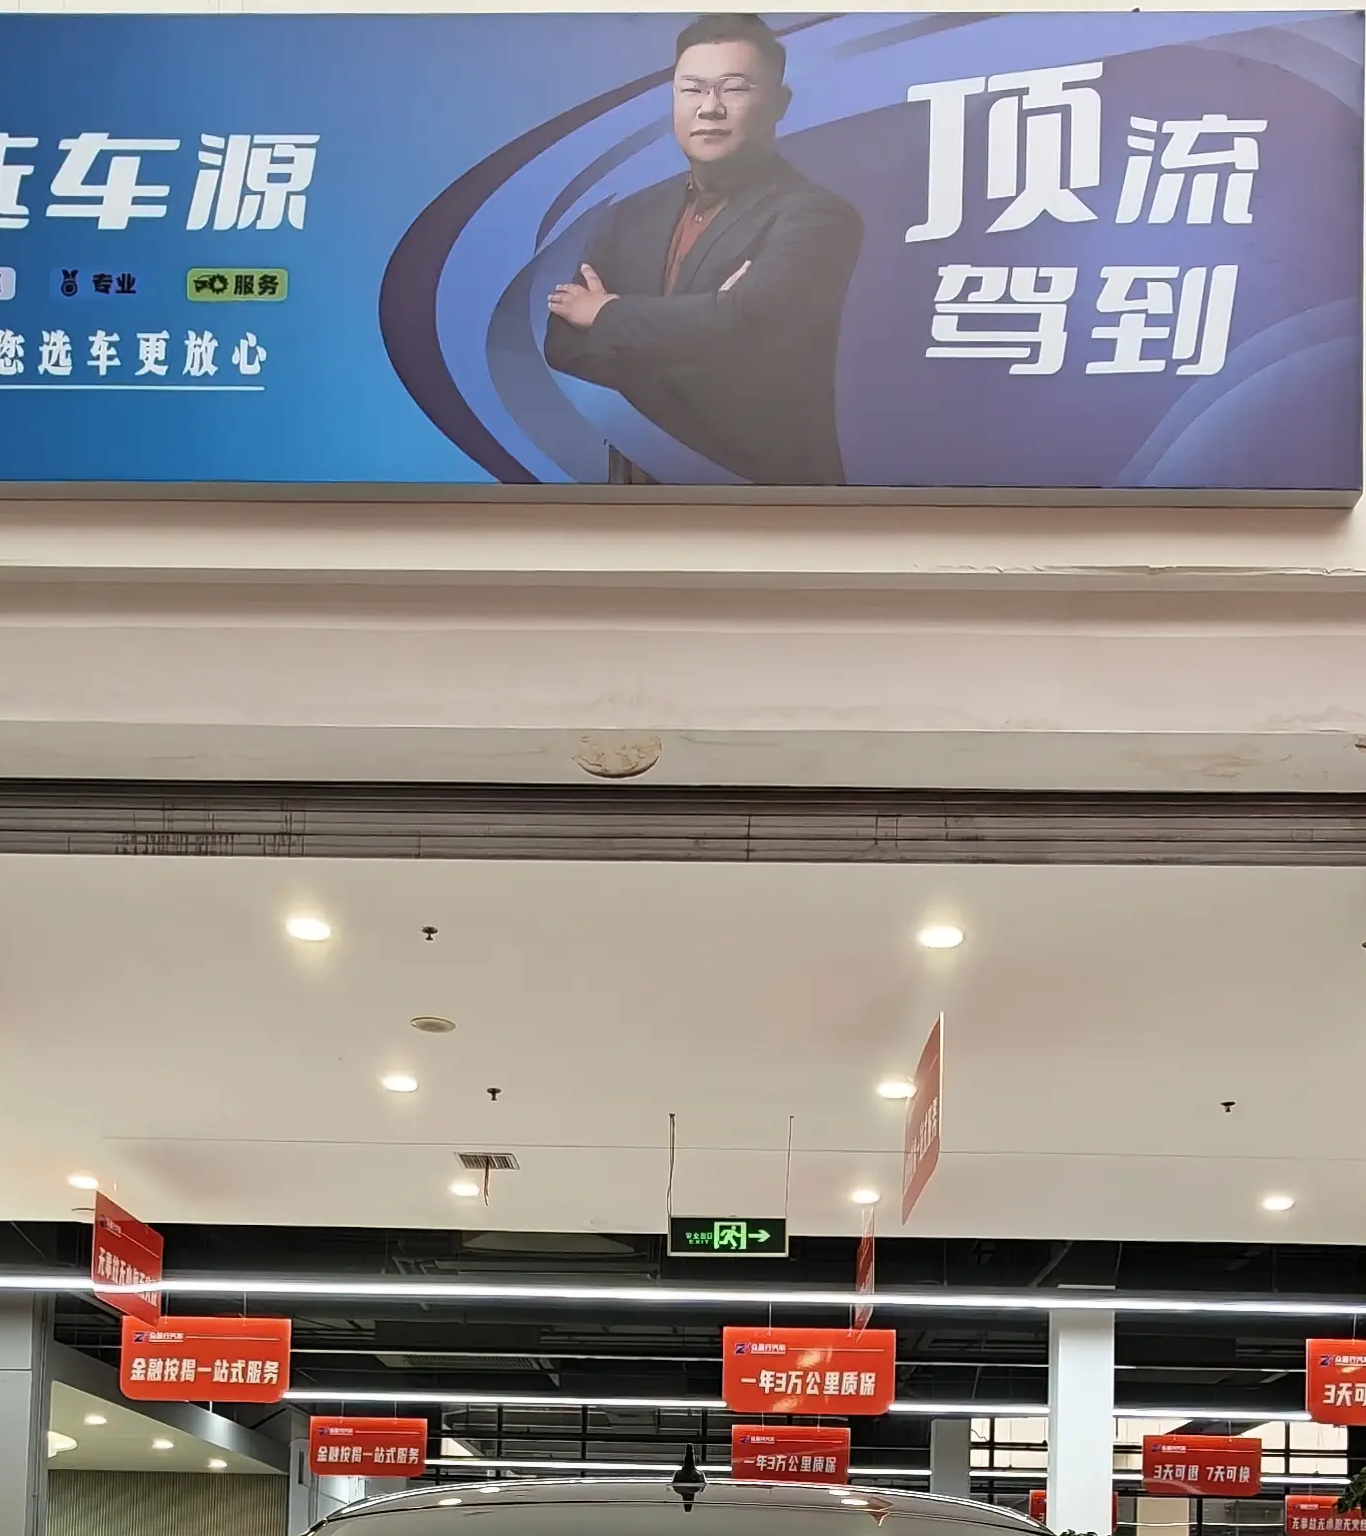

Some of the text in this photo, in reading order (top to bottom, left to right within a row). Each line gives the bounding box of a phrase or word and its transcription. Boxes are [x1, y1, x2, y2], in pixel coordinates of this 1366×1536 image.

[905, 61, 1268, 243] 顶流
[91, 272, 138, 297] 专业
[232, 272, 280, 298] 服务
[925, 263, 1239, 376] 驾到
[130, 1357, 280, 1385] 金融按揭一站式服务
[741, 1369, 877, 1396] 一年3万公里质保
[744, 1455, 837, 1473] 一年3万公里质保
